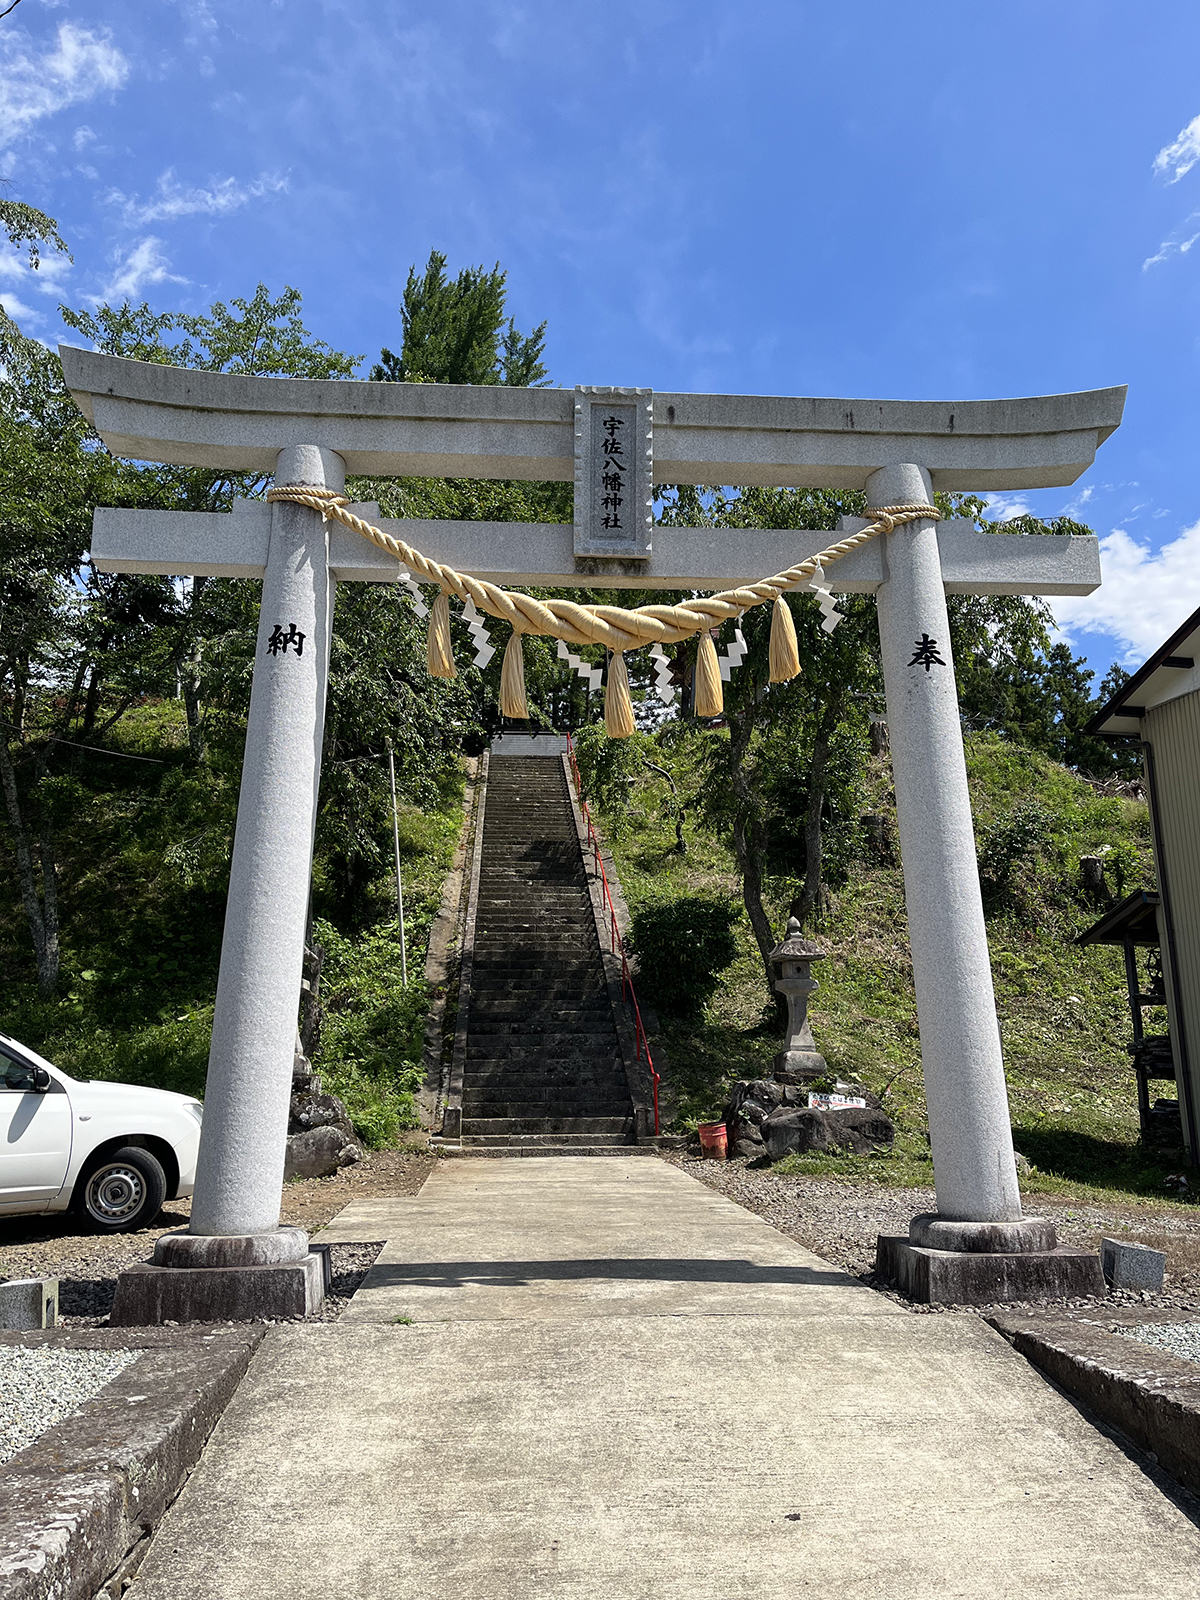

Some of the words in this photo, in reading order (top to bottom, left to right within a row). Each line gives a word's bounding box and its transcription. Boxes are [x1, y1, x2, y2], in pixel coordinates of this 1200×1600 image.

[600, 416, 627, 530] 宇佐八幡神社
[266, 622, 307, 657] 納
[906, 633, 947, 672] 奉
